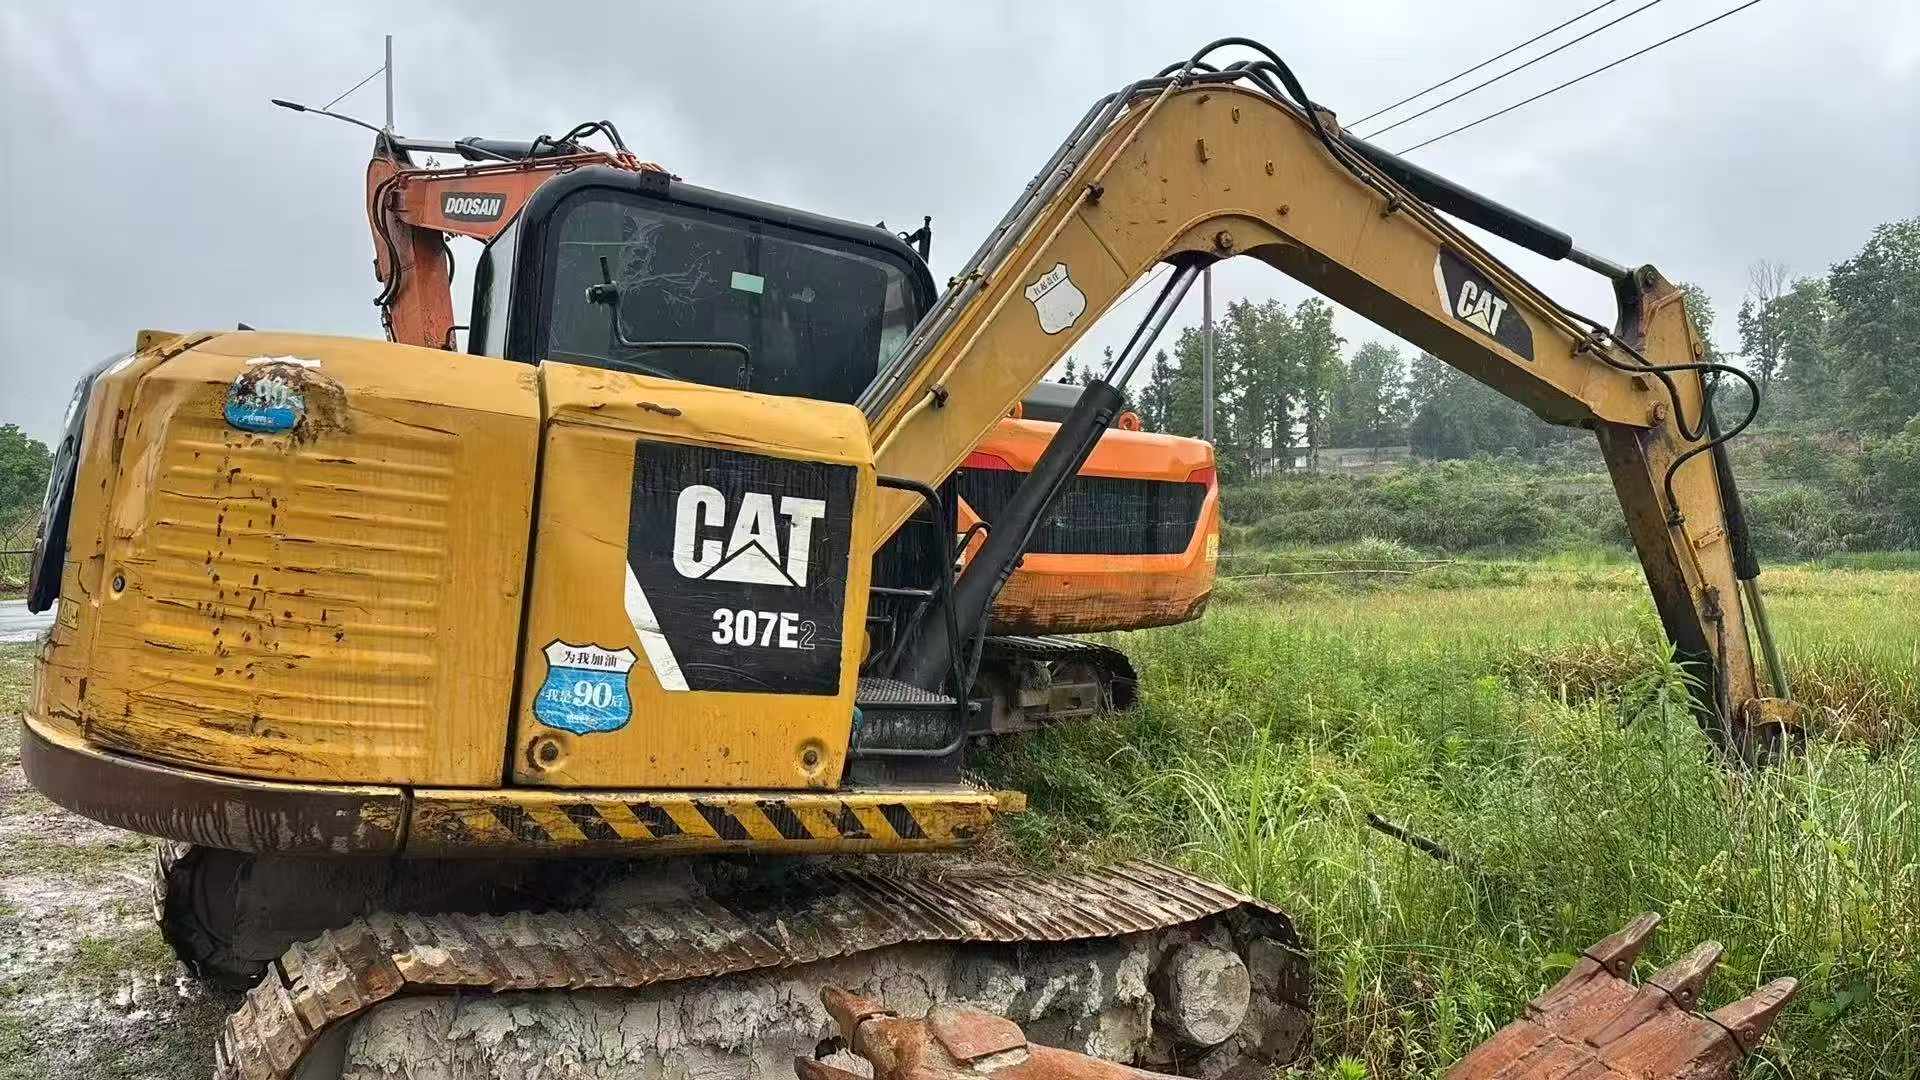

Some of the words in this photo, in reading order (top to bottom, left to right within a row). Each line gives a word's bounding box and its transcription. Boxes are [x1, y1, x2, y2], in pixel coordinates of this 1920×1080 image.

[445, 197, 501, 216] DOOSAN
[1457, 280, 1508, 336] CAT
[673, 485, 826, 588] CAT
[712, 608, 817, 650] 307E2
[562, 650, 618, 668] 为我加油
